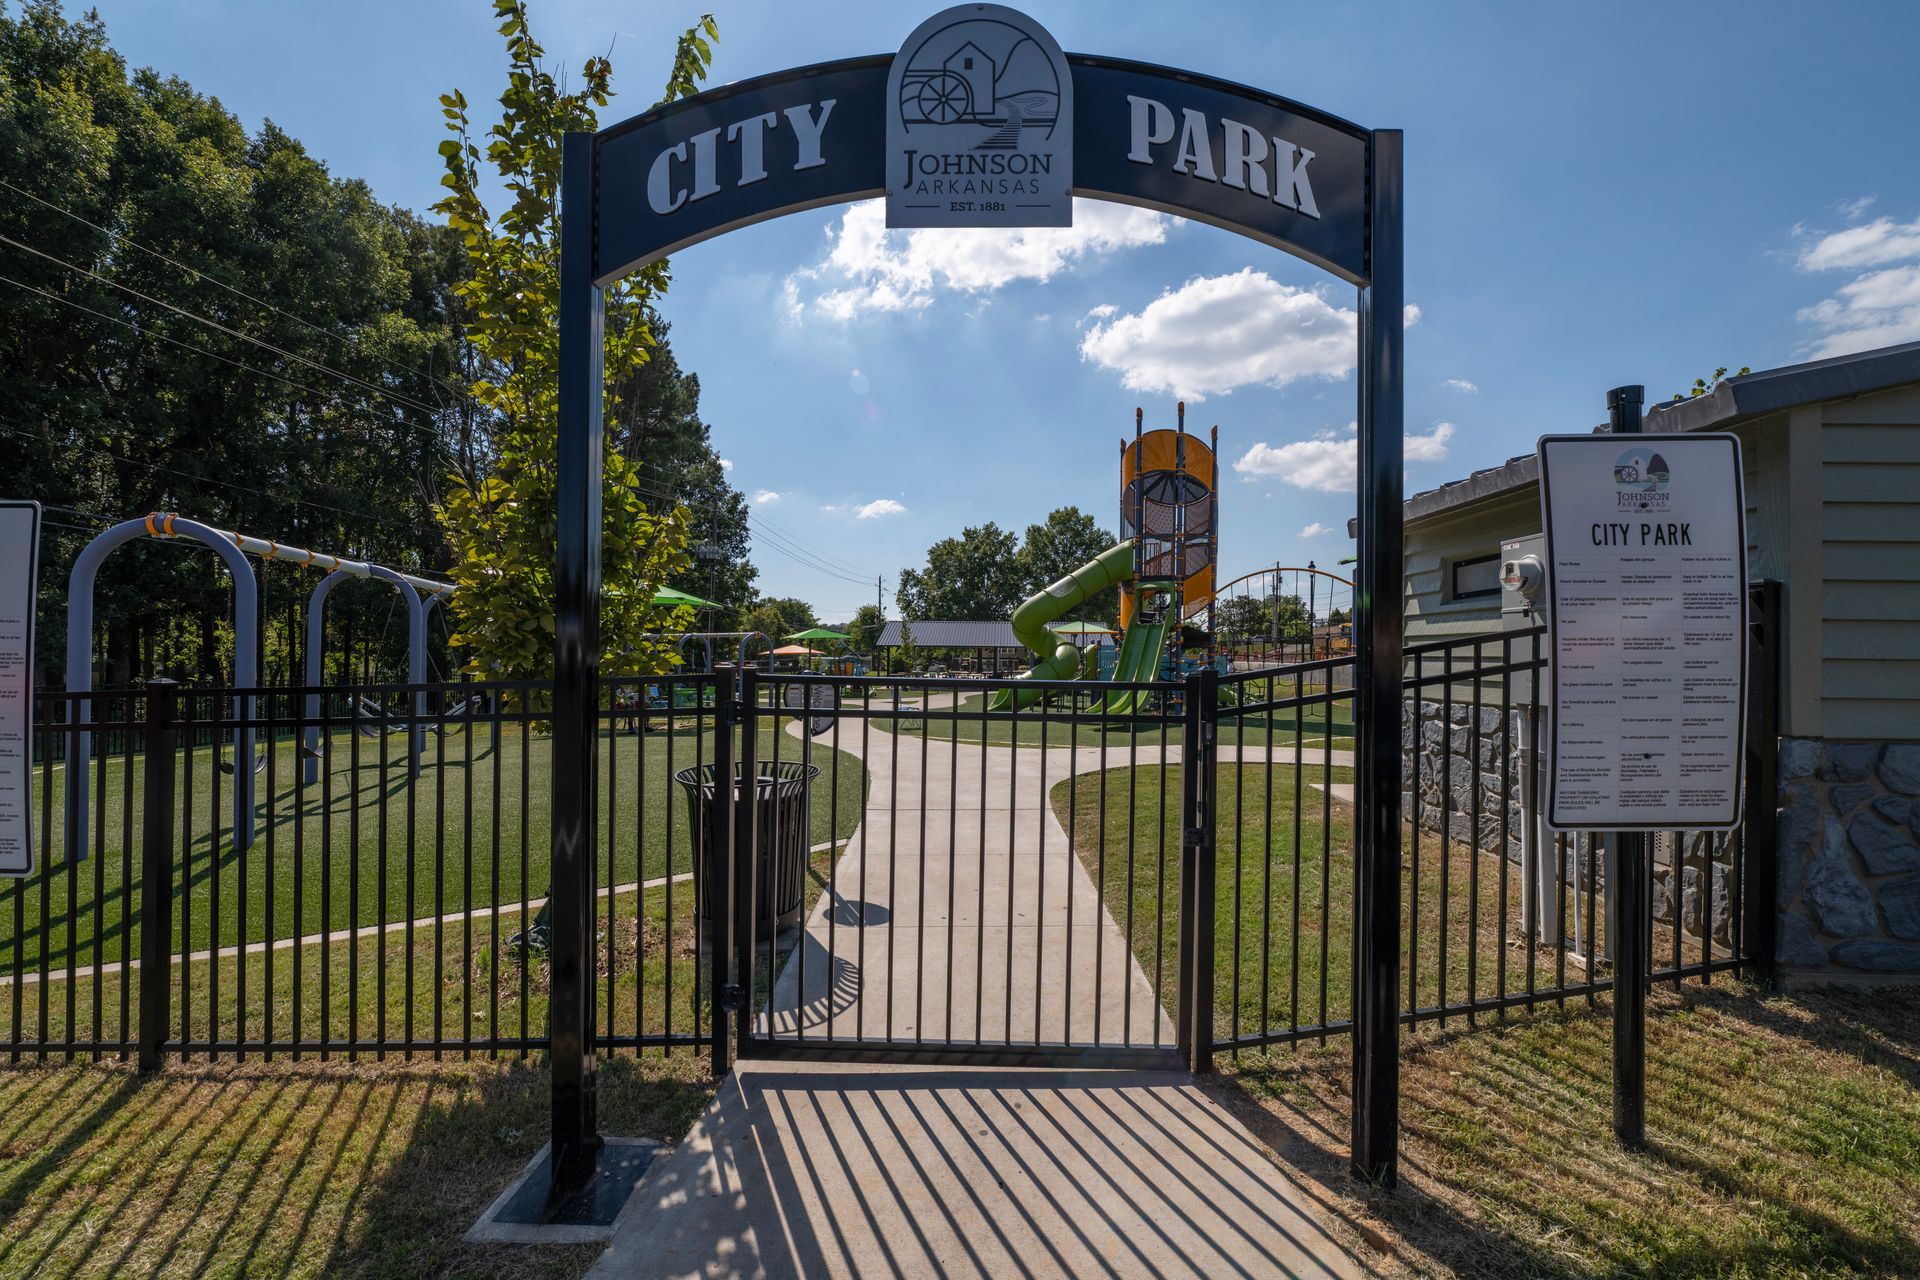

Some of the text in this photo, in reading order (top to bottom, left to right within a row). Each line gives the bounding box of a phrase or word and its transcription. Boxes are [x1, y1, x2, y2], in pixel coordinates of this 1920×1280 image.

[648, 95, 1320, 220] CITY PARK
[903, 150, 1053, 190] JOHNSON
[917, 178, 1040, 194] ARKANSAS
[950, 202, 1005, 212] EST. 1881
[1616, 492, 1669, 505] JOHNSON
[1592, 523, 1692, 546] CITY PARK
